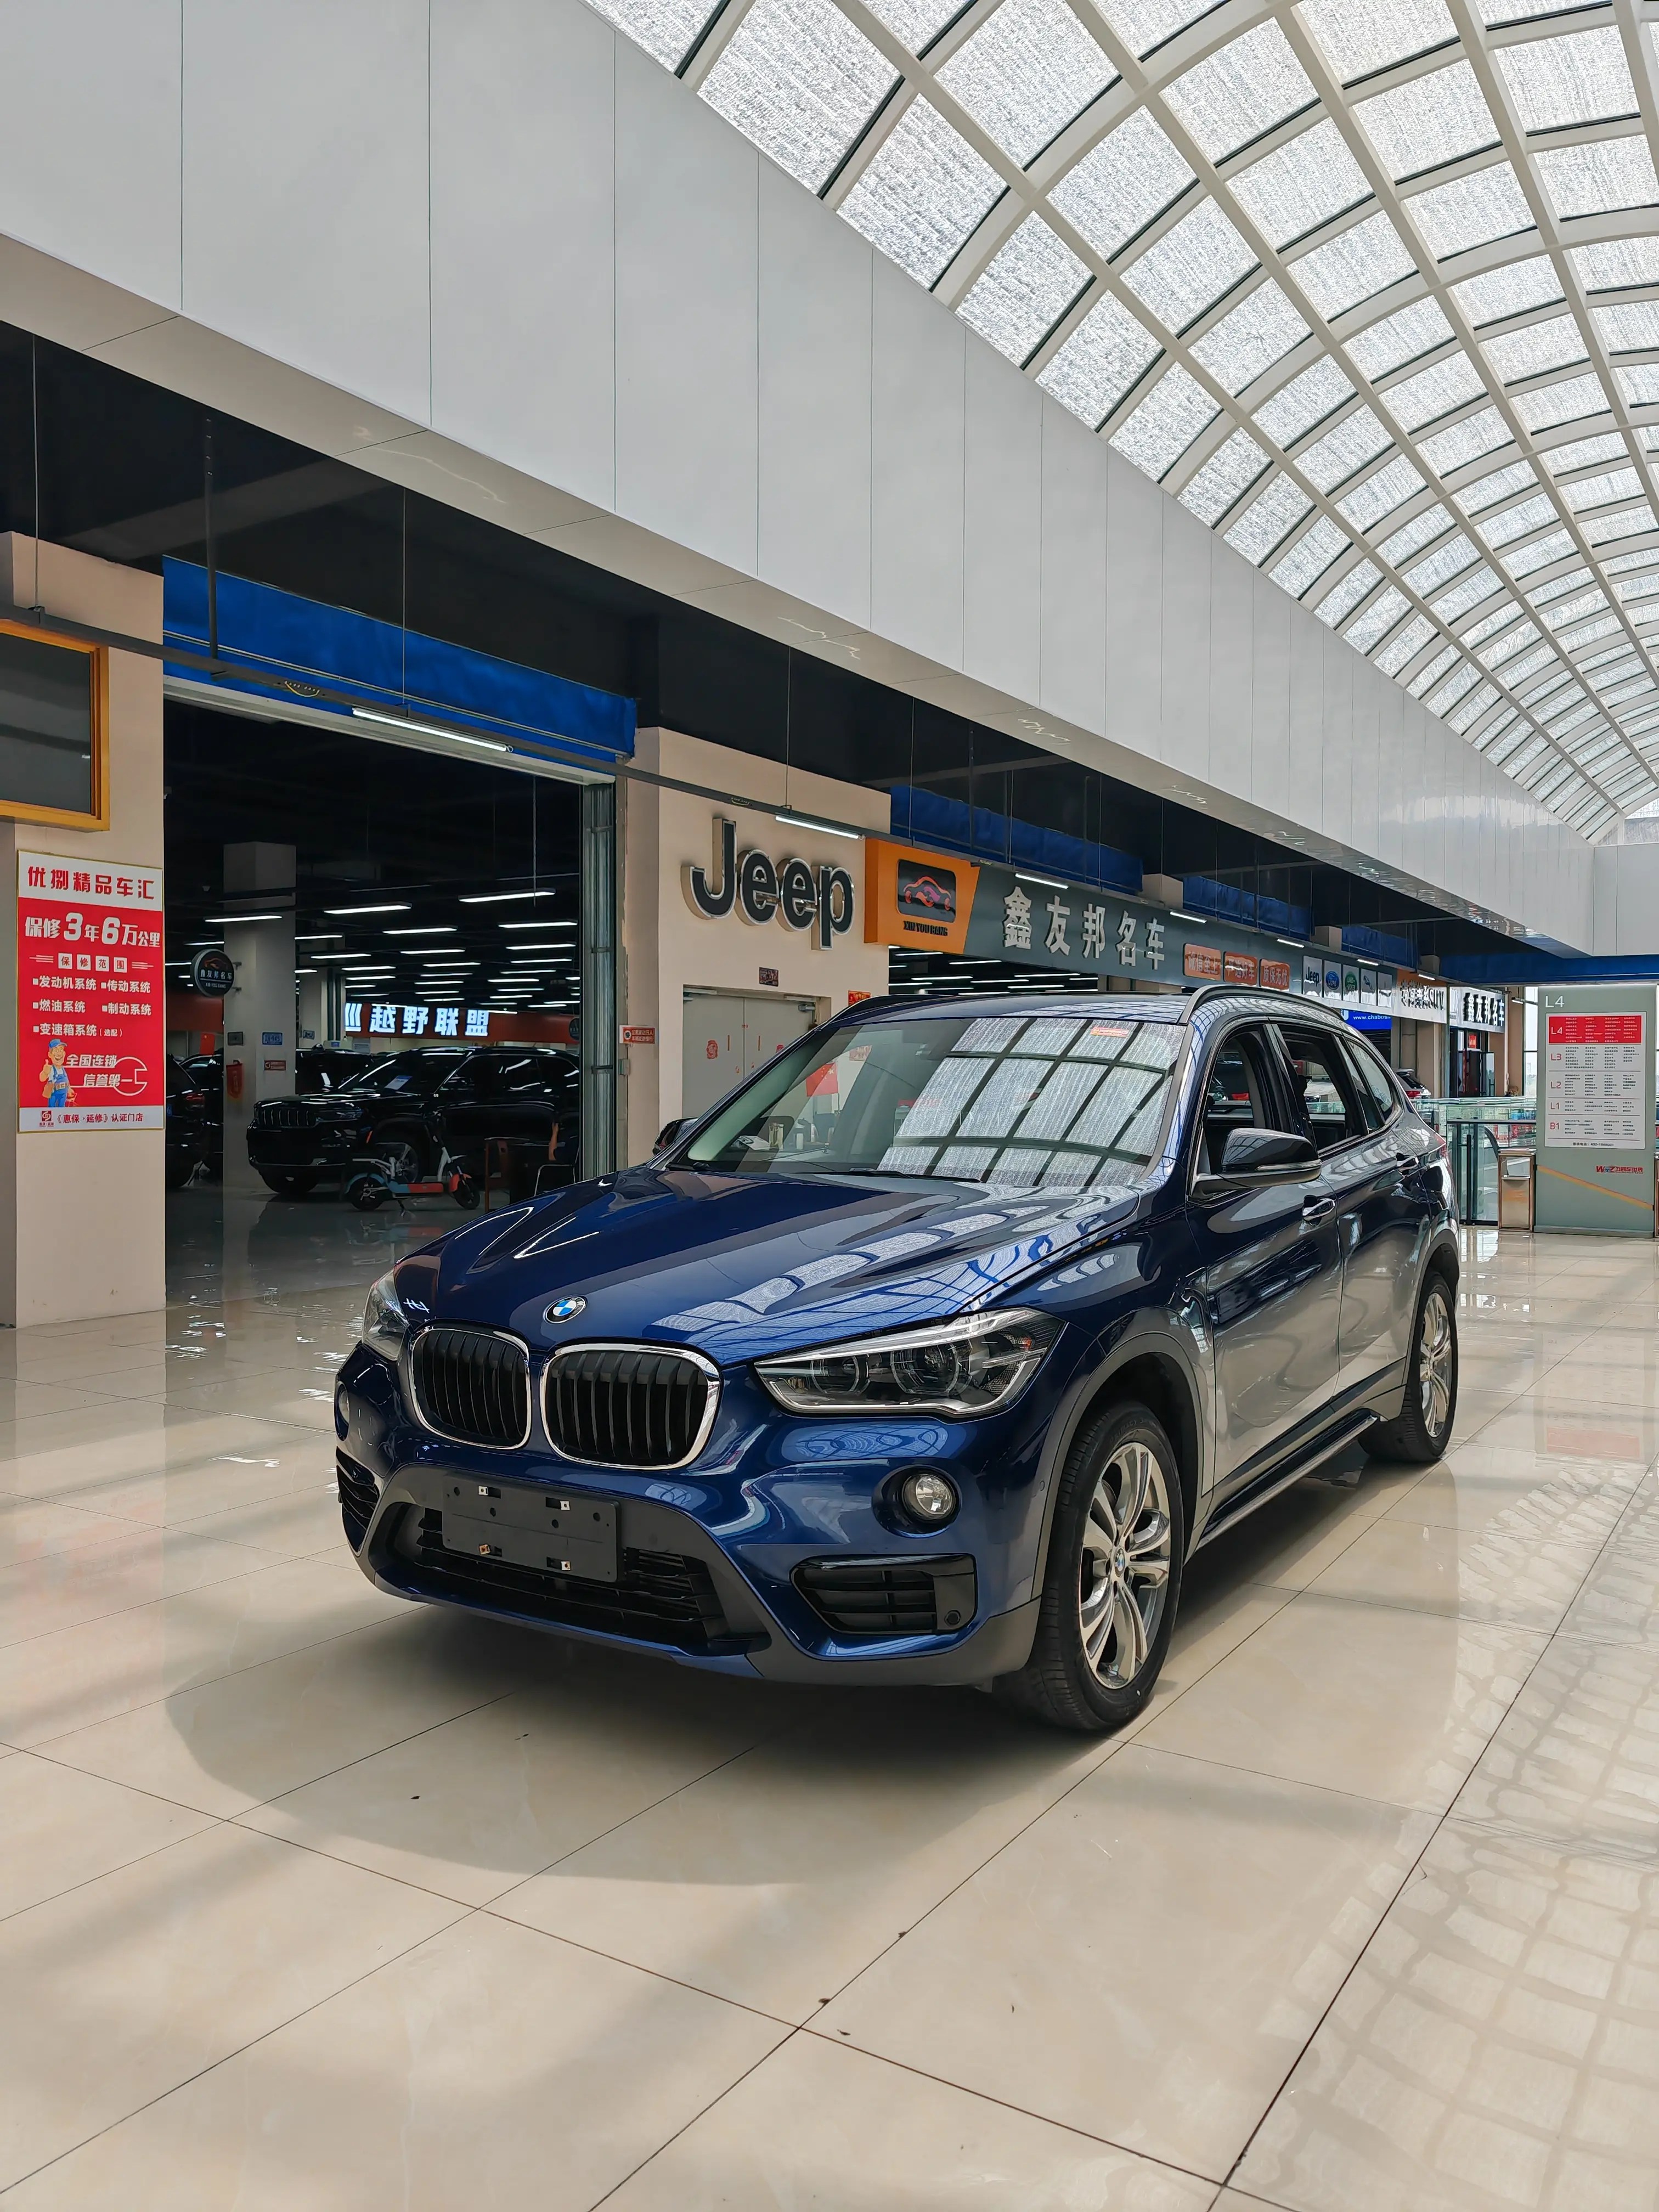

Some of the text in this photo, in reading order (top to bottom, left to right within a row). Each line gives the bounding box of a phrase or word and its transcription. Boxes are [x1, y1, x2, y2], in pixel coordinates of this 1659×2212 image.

[28, 866, 154, 899] 优捌精品车汇
[681, 818, 855, 950] Jeep
[25, 912, 160, 947] 保修3年6万公里
[903, 921, 948, 936] XIN YOU BANG
[1003, 886, 1165, 970] 鑫友邦名车
[39, 975, 97, 991] 发动机系统
[1263, 965, 1288, 986] 质保无忧
[1306, 967, 1319, 987] Jeep
[107, 980, 151, 993] 传动系统
[39, 998, 86, 1013] 燃油系统
[108, 1003, 151, 1015] 制动系统
[1545, 995, 1565, 1008] L4
[1551, 1026, 1562, 1035] L4
[66, 1054, 117, 1067] 全国连锁
[83, 1074, 133, 1087] 信誉第一
